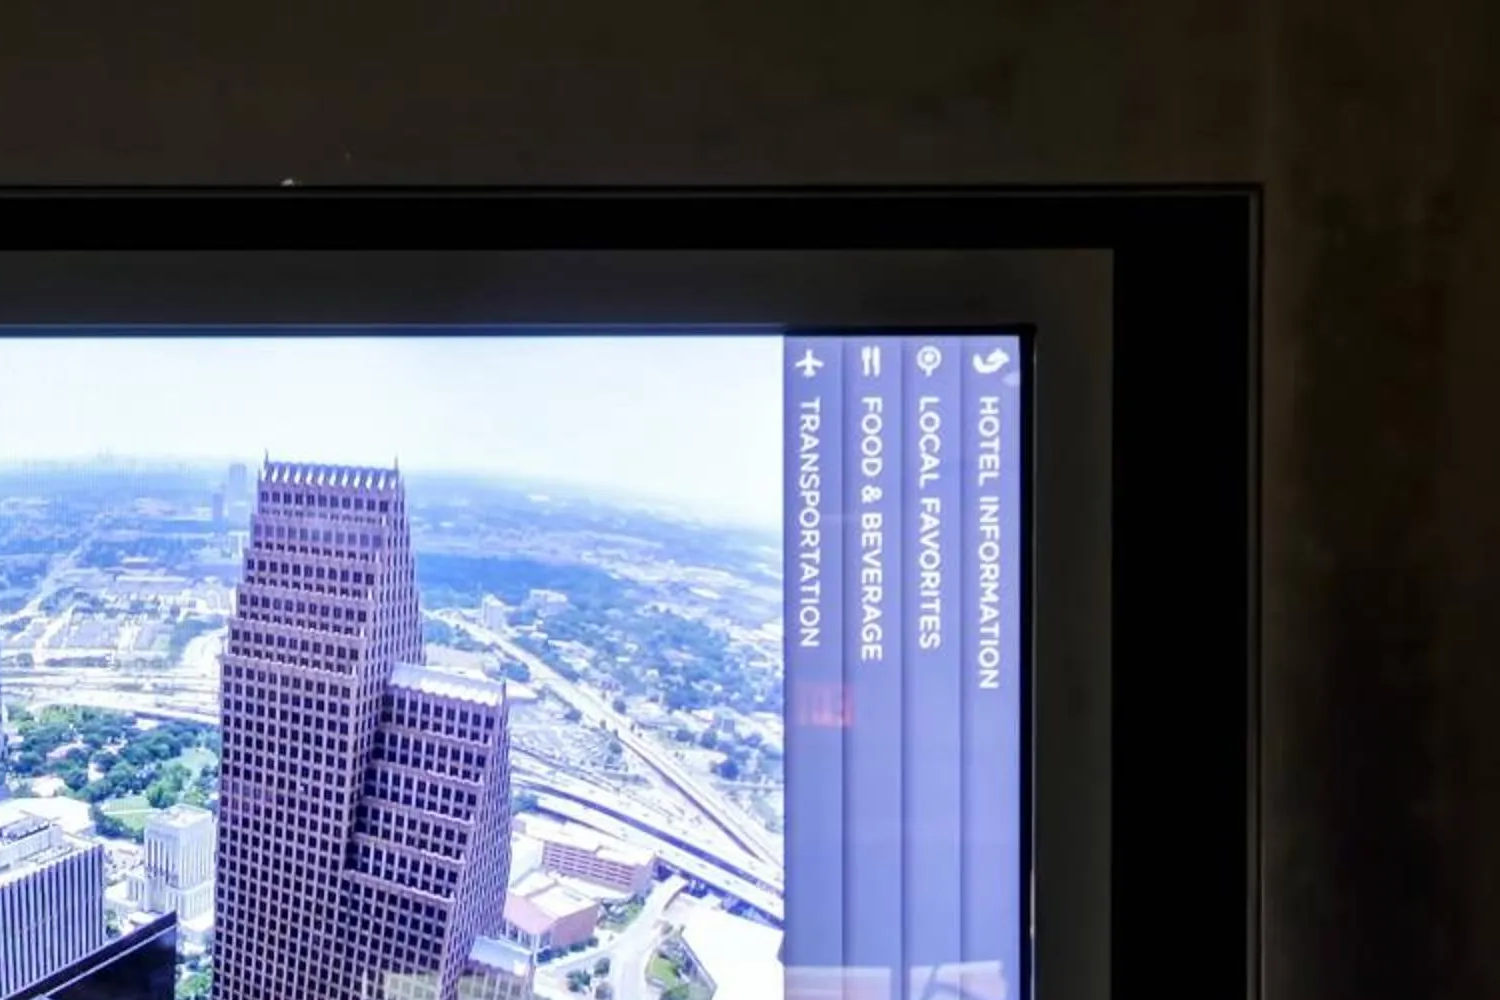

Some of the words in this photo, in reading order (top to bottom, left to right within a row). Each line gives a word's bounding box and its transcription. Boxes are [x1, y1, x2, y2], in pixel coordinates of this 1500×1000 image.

[861, 397, 882, 477] FOOD
[861, 485, 882, 502] &
[919, 396, 941, 489] LOCAL
[978, 396, 999, 486] HOTEL
[799, 397, 820, 647] TRANSPORTATION
[919, 498, 941, 650] FAVORITES
[861, 513, 882, 661] BEVERAGE
[978, 497, 1000, 689] INFORMATION
